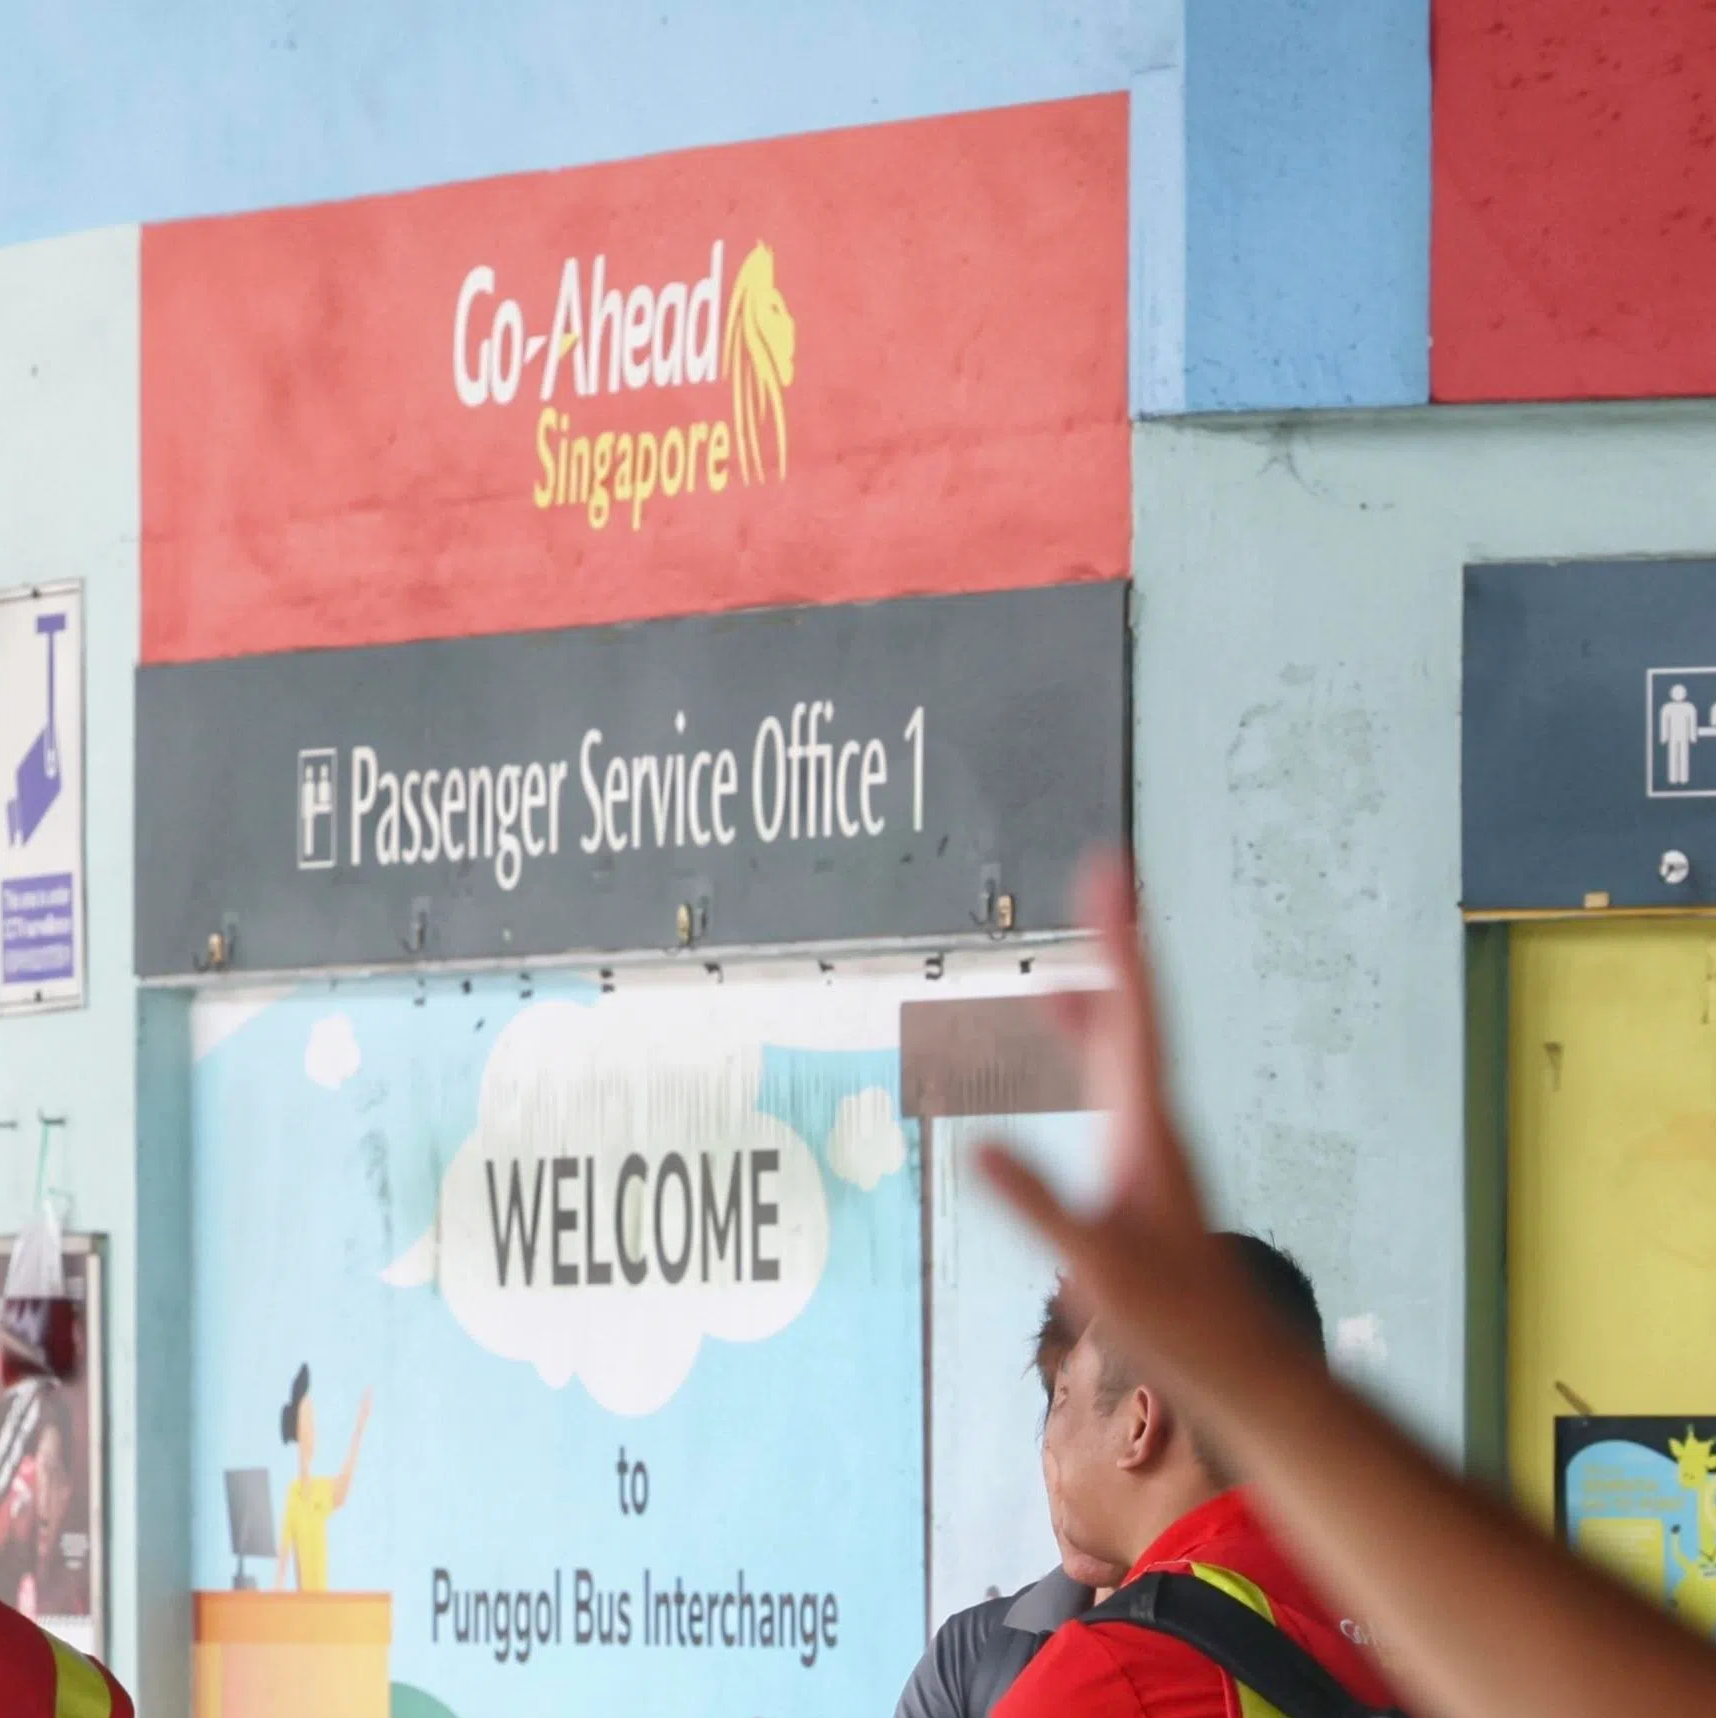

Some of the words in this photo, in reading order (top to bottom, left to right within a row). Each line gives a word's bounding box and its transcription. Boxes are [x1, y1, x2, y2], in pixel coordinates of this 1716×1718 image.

[454, 239, 724, 407] Go-Ahead
[533, 405, 730, 530] Singapore
[351, 745, 567, 890] Passenger
[580, 710, 738, 853] Service
[752, 700, 888, 842] Office
[904, 705, 925, 833] 1
[485, 1148, 781, 1287] WELCOME
[616, 1445, 650, 1516] to
[431, 1568, 561, 1664] Punggol
[574, 1568, 633, 1647] Bus
[644, 1568, 840, 1669] Interchange
